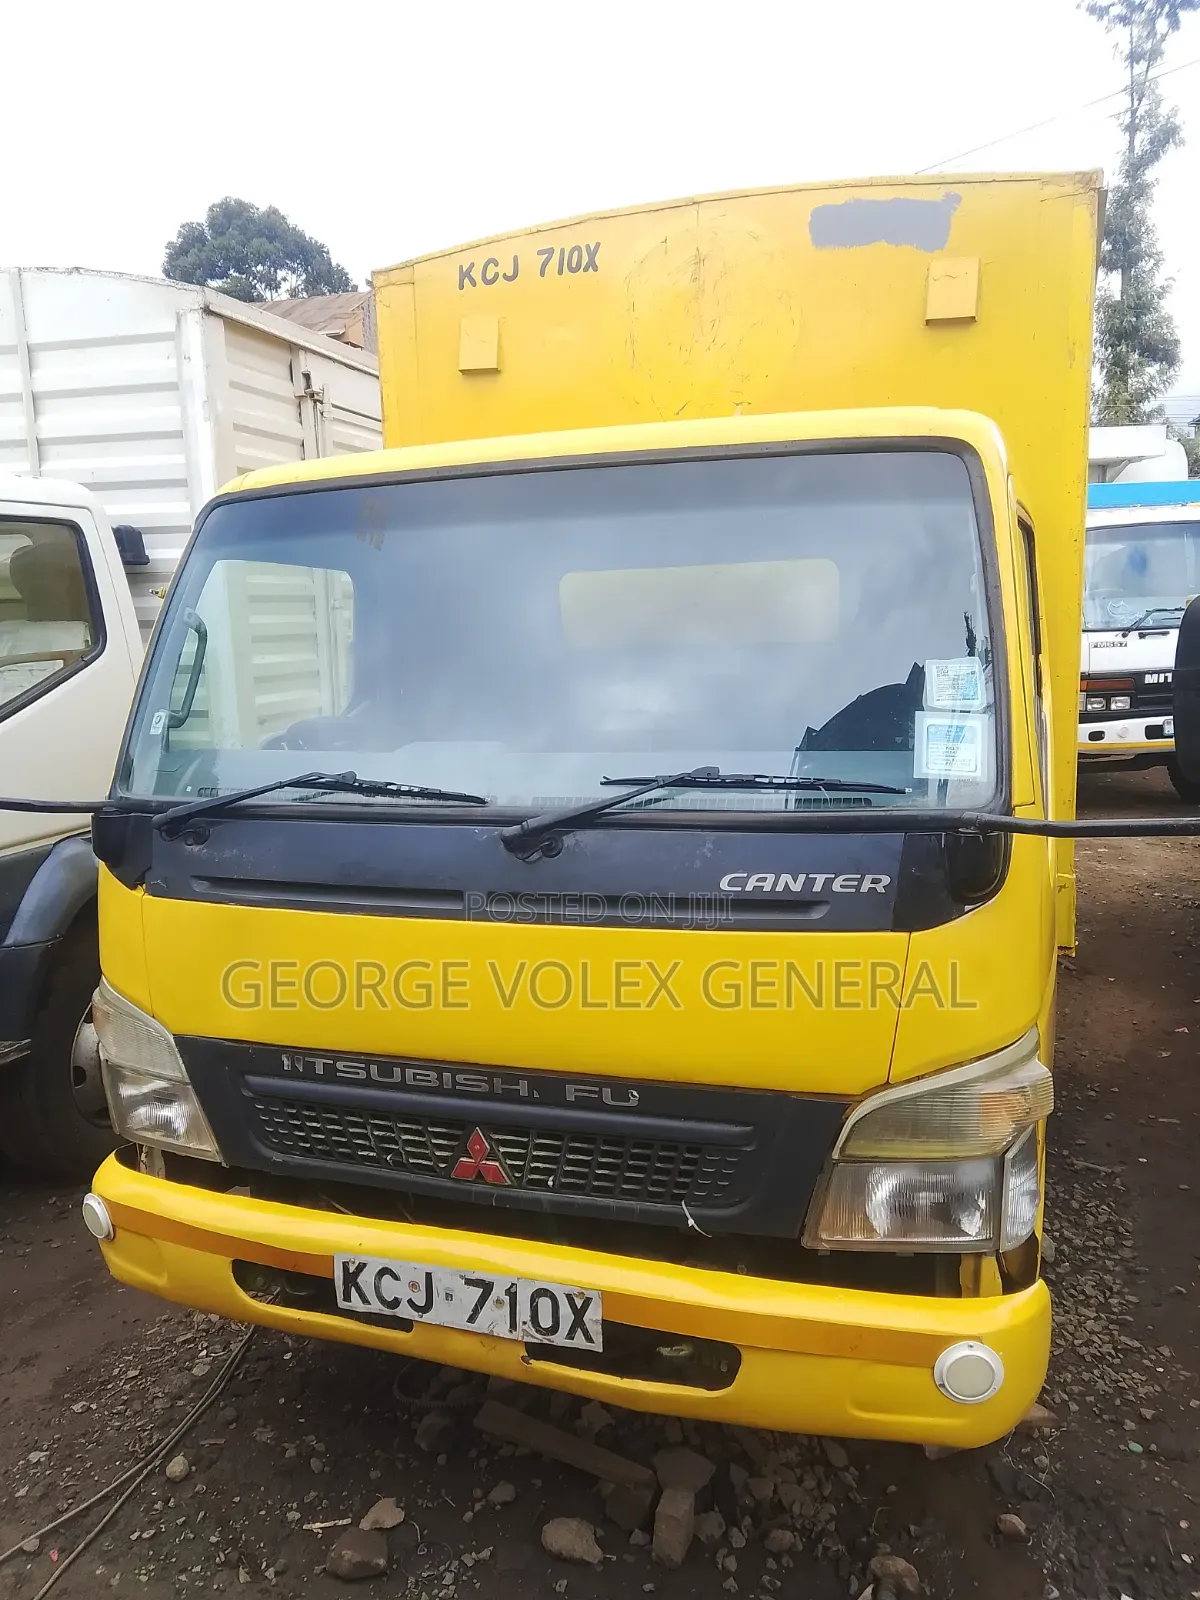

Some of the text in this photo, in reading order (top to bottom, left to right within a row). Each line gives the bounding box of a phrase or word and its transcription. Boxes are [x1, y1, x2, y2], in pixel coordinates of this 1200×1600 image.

[458, 241, 601, 291] KCJ 710X
[719, 873, 892, 893] CANTER
[341, 1260, 594, 1344] KCJ 710X
